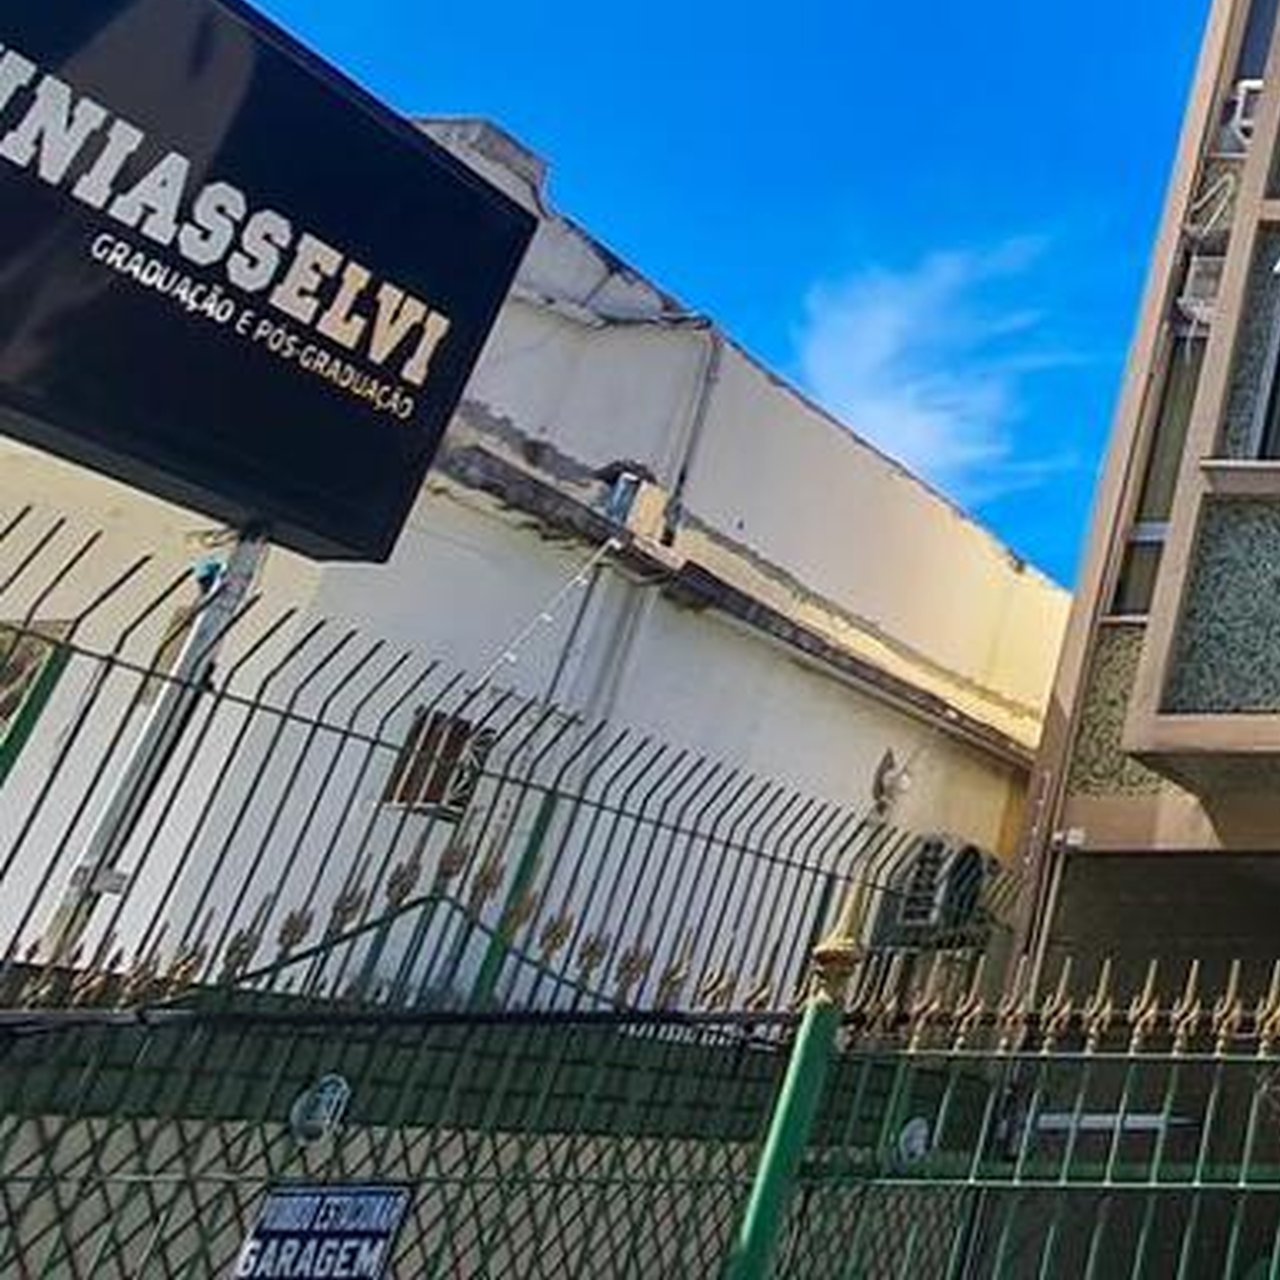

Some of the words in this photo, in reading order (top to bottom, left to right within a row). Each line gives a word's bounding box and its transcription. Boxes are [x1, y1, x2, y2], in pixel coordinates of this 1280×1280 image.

[91, 232, 236, 324] GRADUAÇÃO
[235, 310, 254, 335] E
[252, 319, 415, 420] PÓS-GRADUAÇÃO
[236, 1236, 386, 1278] GARAGEM
